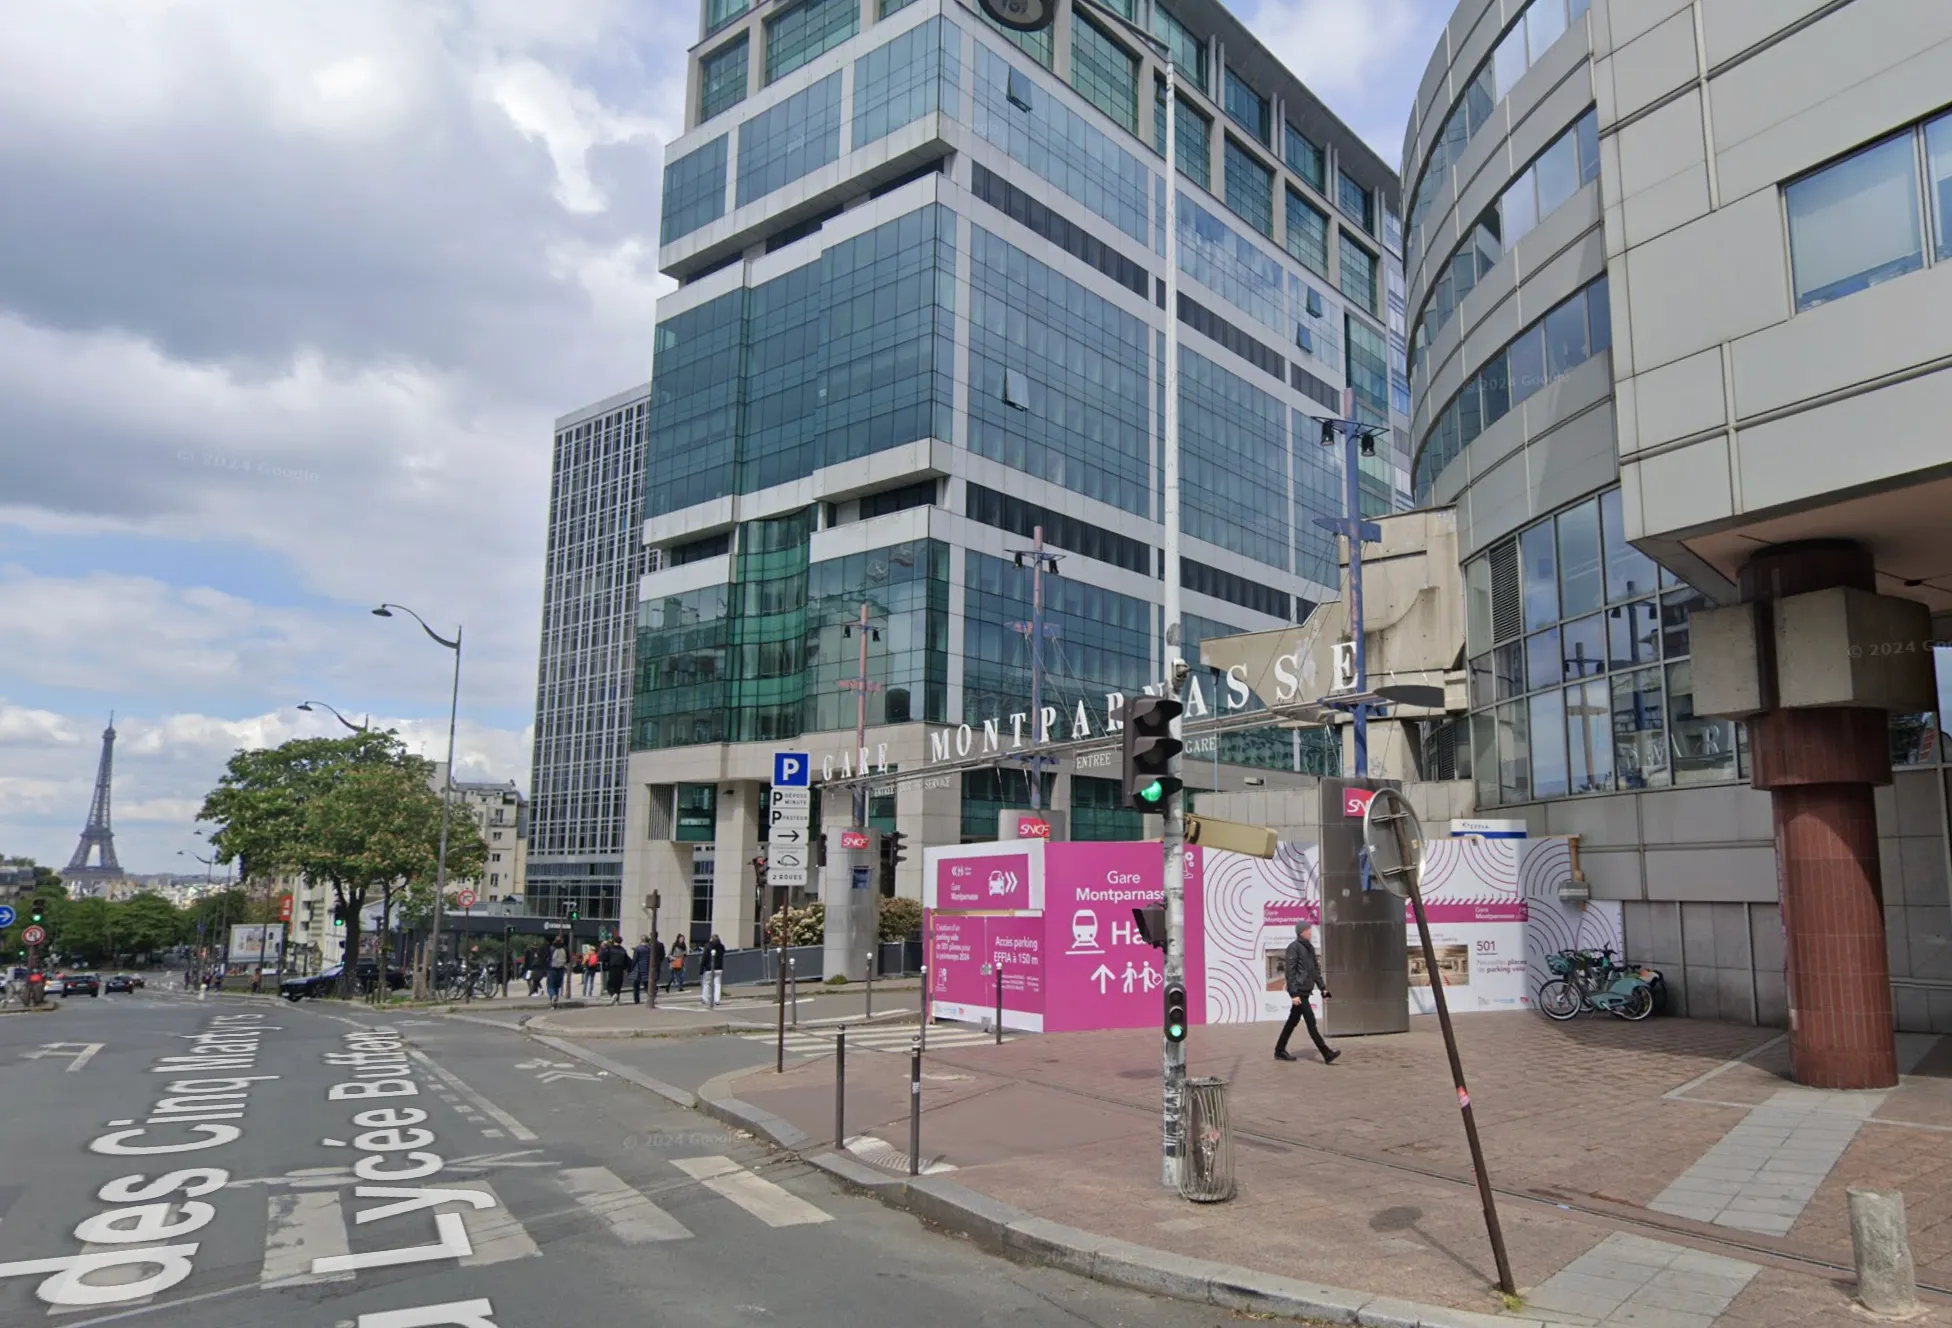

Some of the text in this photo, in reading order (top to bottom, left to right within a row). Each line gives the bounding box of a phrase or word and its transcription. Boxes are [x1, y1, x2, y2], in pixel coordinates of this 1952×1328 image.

[823, 641, 1358, 781] GARE MONTPARASSE
[1076, 737, 1217, 769] ENTREE GARE
[782, 758, 800, 781] P
[772, 792, 783, 805] P
[772, 811, 782, 824] P
[1020, 823, 1051, 835] SNCF
[842, 836, 869, 847] SNCF
[1107, 870, 1141, 884] Gare
[995, 936, 1038, 951] Accès parking
[1476, 940, 1496, 952] 501
[994, 951, 1012, 963] EFFIA
[1018, 953, 1030, 964] 150
